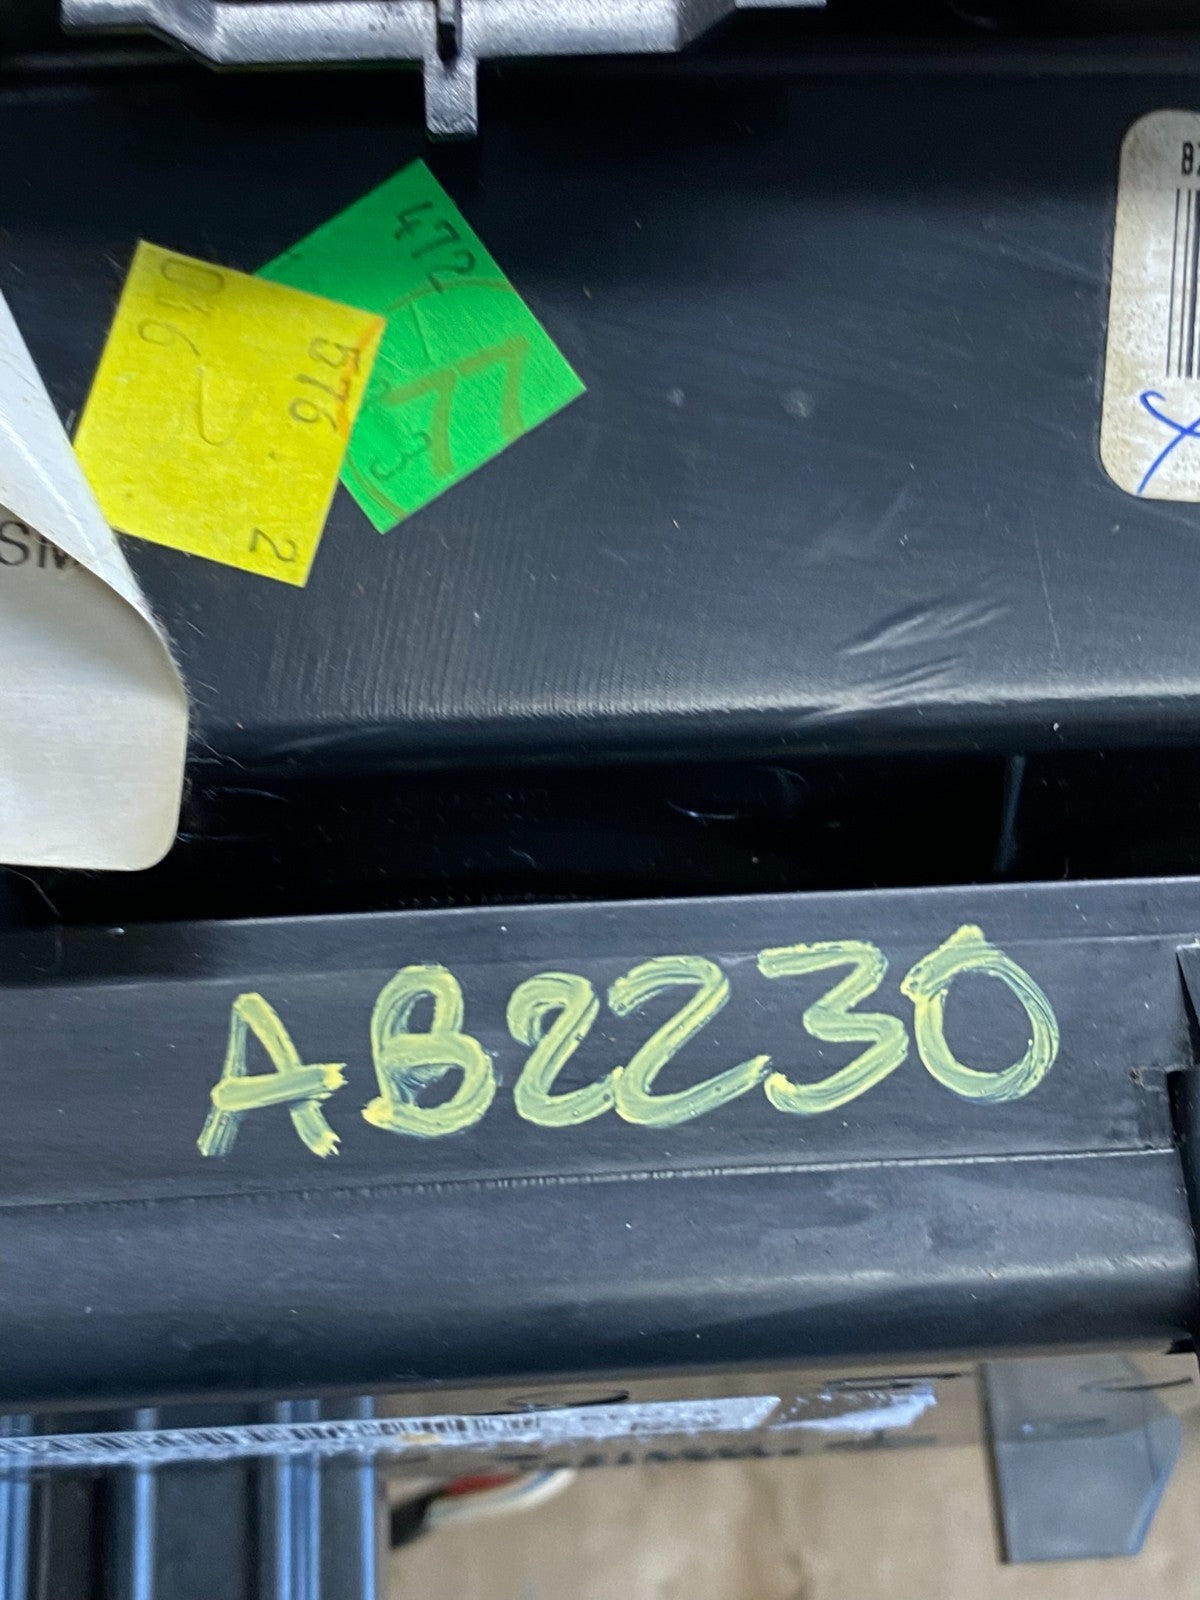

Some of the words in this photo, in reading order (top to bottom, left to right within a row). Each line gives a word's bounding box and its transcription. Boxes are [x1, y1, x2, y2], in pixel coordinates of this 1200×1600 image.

[395, 199, 477, 293] 472
[248, 526, 299, 564] 2
[197, 924, 1060, 1158] AB2230
